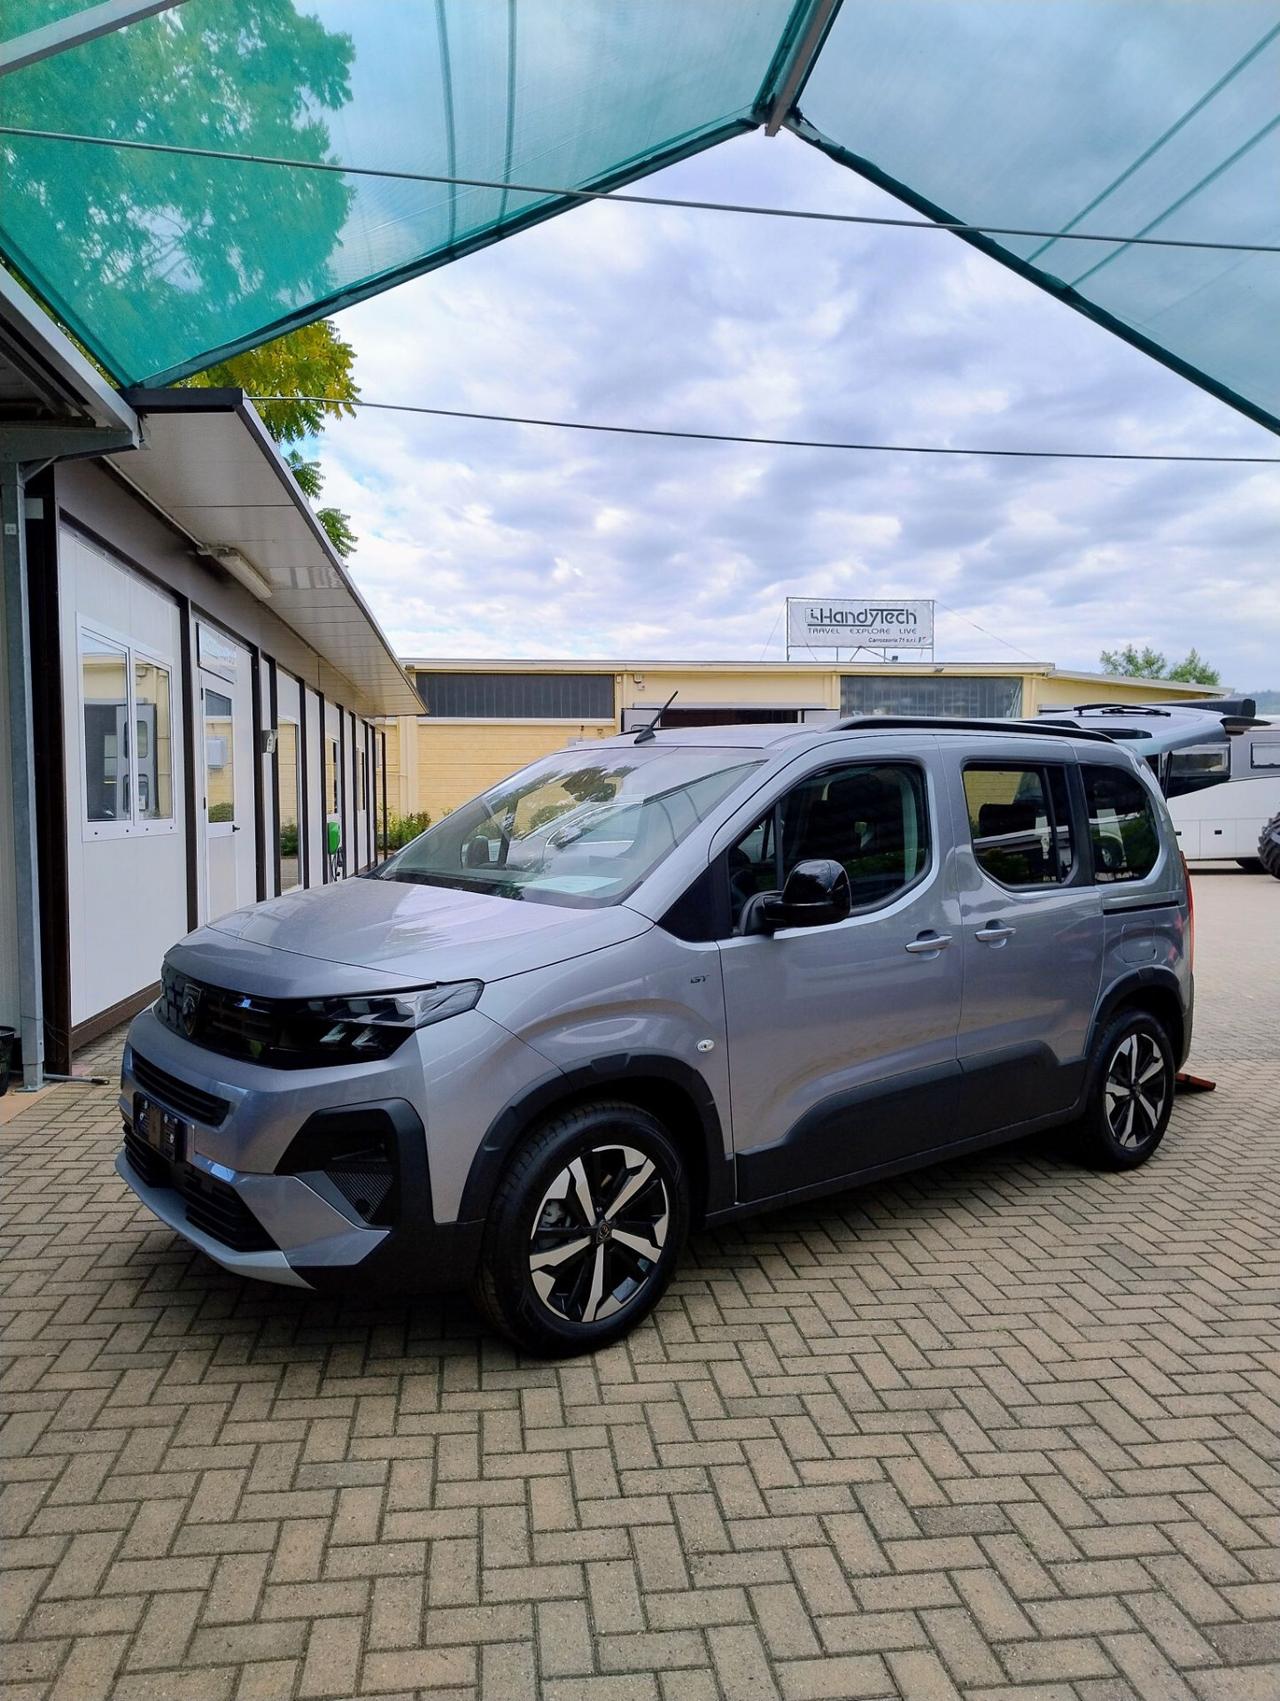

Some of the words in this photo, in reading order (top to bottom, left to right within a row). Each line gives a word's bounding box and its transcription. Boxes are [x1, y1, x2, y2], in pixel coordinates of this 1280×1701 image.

[820, 608, 917, 626] HandyTech
[808, 627, 841, 635] TRAVEL
[849, 627, 891, 635] EXPLORE
